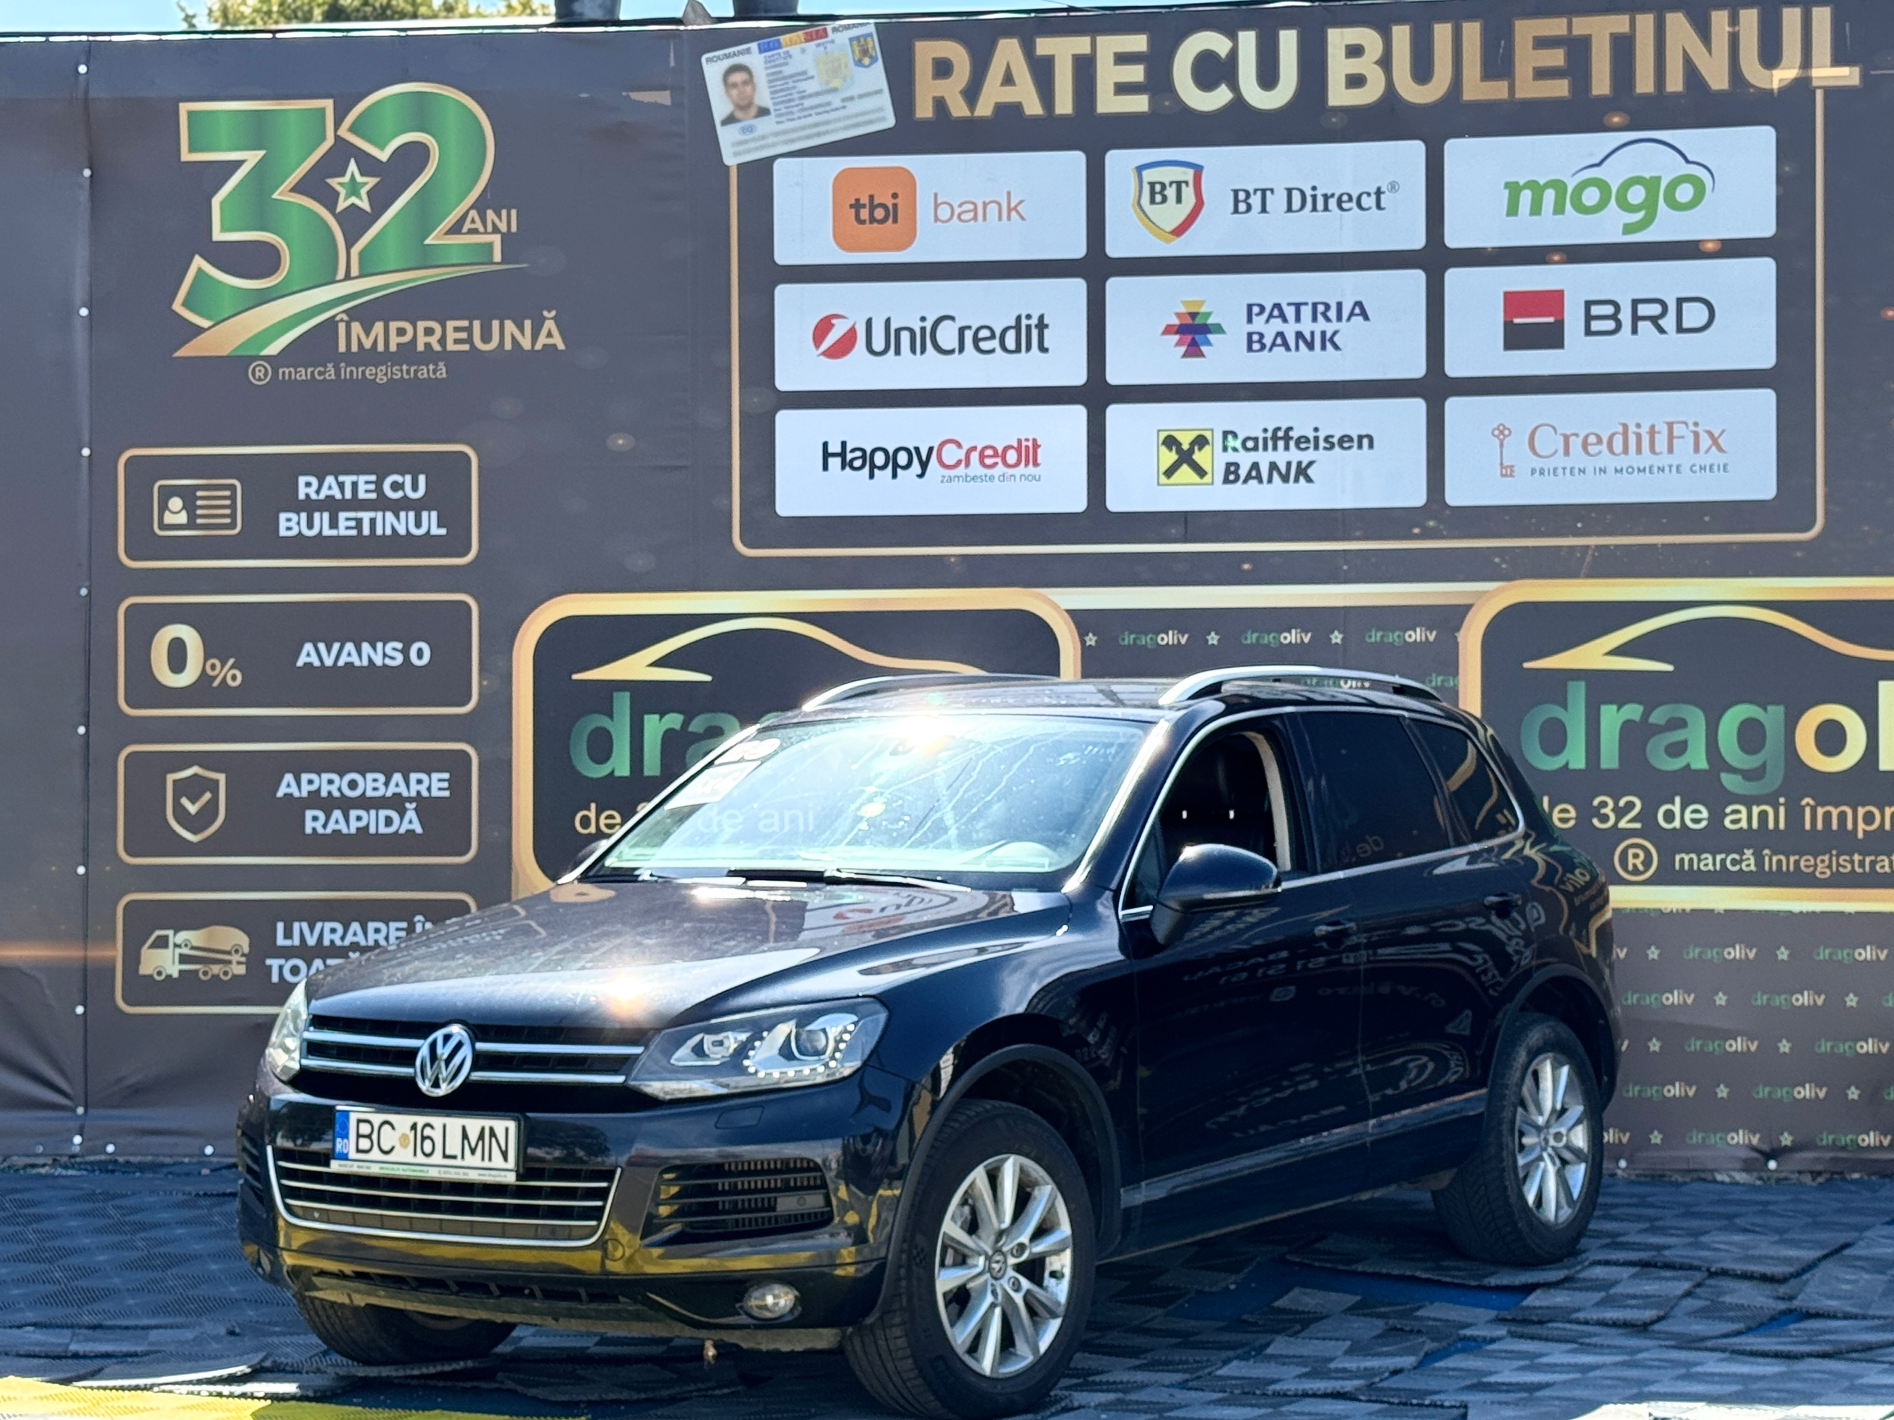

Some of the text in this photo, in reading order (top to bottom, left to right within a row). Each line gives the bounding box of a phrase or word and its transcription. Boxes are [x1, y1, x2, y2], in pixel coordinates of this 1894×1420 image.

[705, 47, 752, 65] ROUMANIE
[914, 34, 1150, 119] RATE
[1171, 29, 1298, 113] CU
[1326, 5, 1861, 107] BULETINUL
[172, 82, 502, 328] 32
[1147, 180, 1189, 205] BT
[1230, 187, 1274, 215] BT
[1503, 173, 1706, 236] mogo
[849, 190, 1027, 225] tbi bank
[462, 209, 518, 233] ANI
[1246, 300, 1371, 325] PATRIA
[1583, 296, 1716, 337] BRD
[335, 310, 566, 353] ÎMPREUNĂ
[865, 313, 1049, 357] UniCredit
[1246, 329, 1342, 354] BANK
[278, 363, 336, 381] marcă
[340, 361, 447, 384] înregistrată
[1221, 426, 1375, 453] Raiffeisen
[1527, 420, 1727, 459] CreditFix
[822, 437, 1041, 480] HappyCredit
[1530, 462, 1730, 478] PRIETEN IN MOMENTE CHEIE
[940, 472, 1042, 484] zambeste din nou
[1222, 460, 1317, 485] BANK
[298, 474, 426, 500] RATE CU
[278, 511, 447, 537] BULETINUL
[1118, 626, 1437, 649] dragoliv dragoliv dragoliv
[296, 641, 431, 667] AVANS 0
[276, 772, 450, 798] APROBARE
[304, 802, 423, 835] RAPIDĂ
[574, 803, 622, 834] de
[758, 808, 814, 832] ani
[1542, 795, 1578, 829] e
[1591, 795, 1643, 830] 32
[1657, 795, 1709, 830] de
[1723, 797, 1786, 831] ani
[1674, 848, 1757, 872] marcă
[1683, 944, 1757, 962] dragoliv
[1813, 945, 1889, 963] dragoliv
[1622, 989, 1826, 1009] dragoliv dragoliv
[1685, 1036, 1891, 1056] dragoliv dragoliv
[1622, 1081, 1828, 1101] dragoliv dragoliv
[335, 1138, 349, 1154] RO
[1685, 1129, 1761, 1147] dragoliv
[1815, 1131, 1892, 1149] dragoliv
